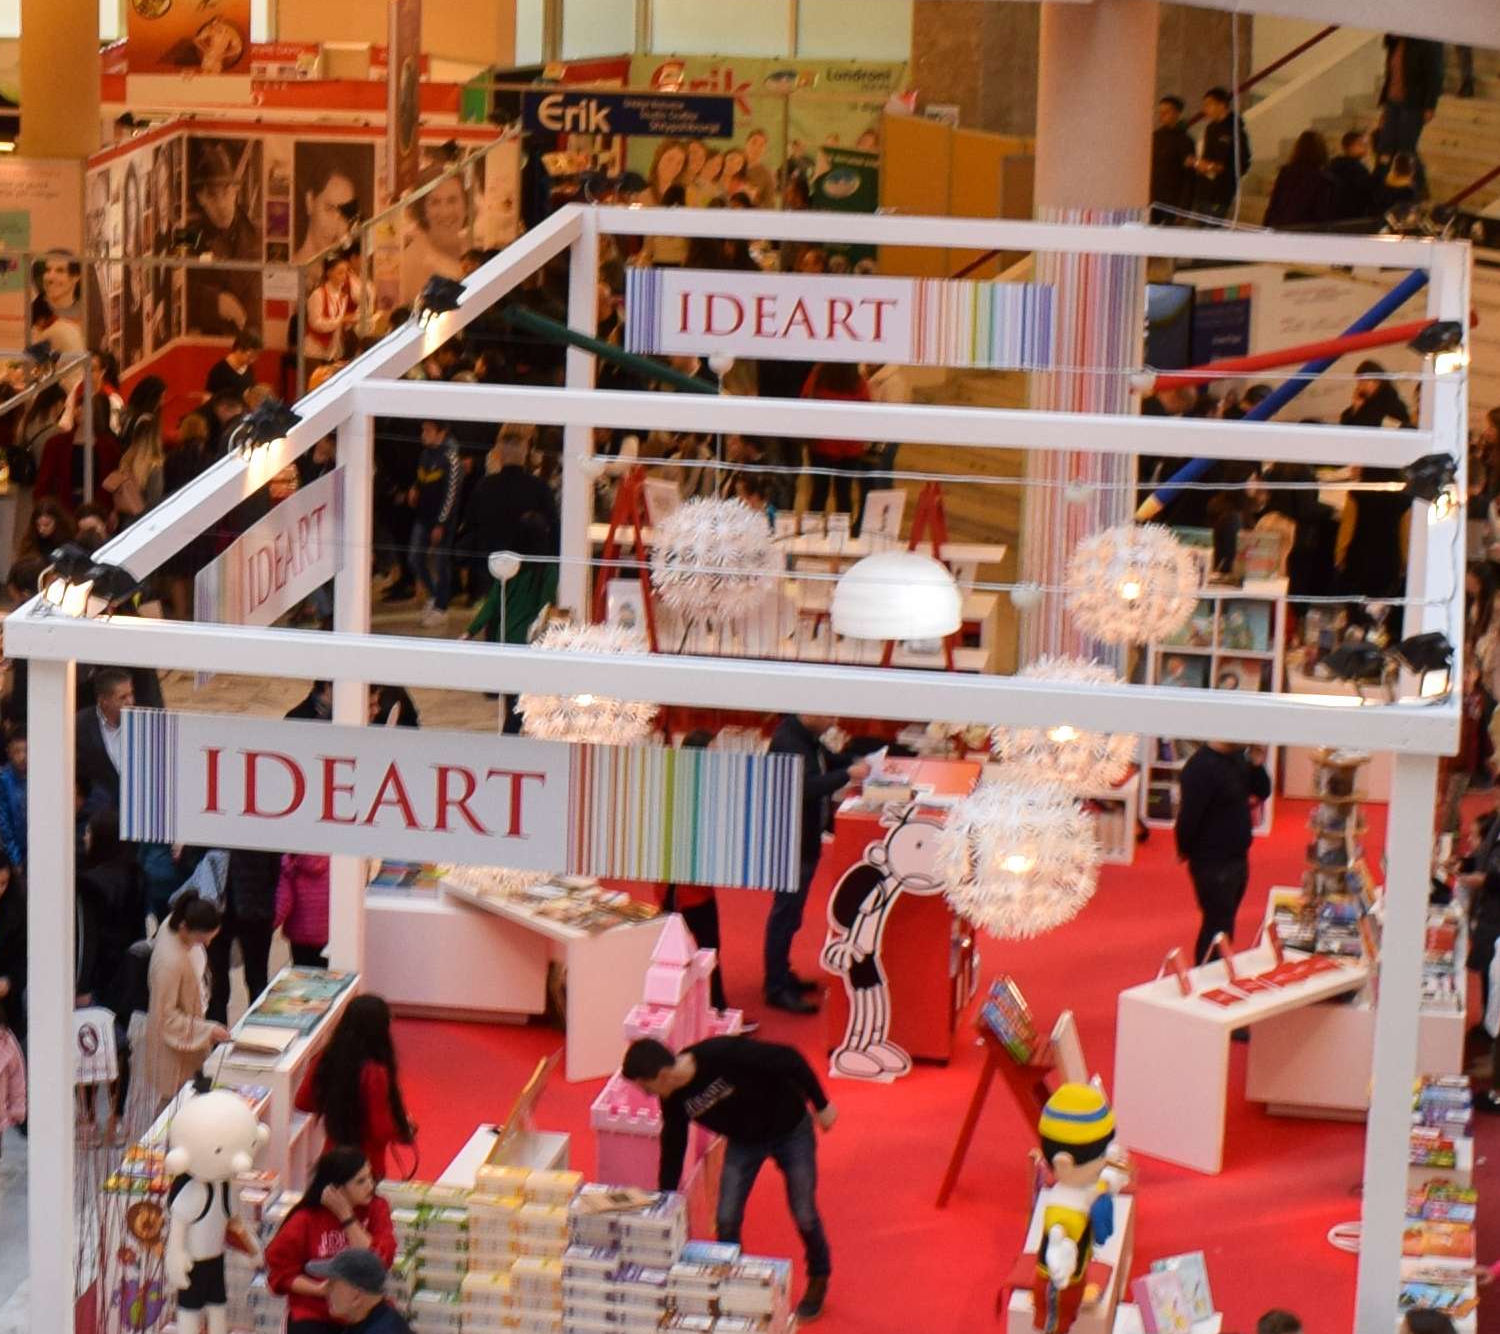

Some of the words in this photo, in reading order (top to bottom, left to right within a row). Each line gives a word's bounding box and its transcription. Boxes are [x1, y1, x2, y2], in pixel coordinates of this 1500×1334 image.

[538, 94, 611, 134] Erik
[678, 291, 898, 344] IDEART
[248, 504, 327, 614] IDEART
[201, 747, 548, 840] IDEART
